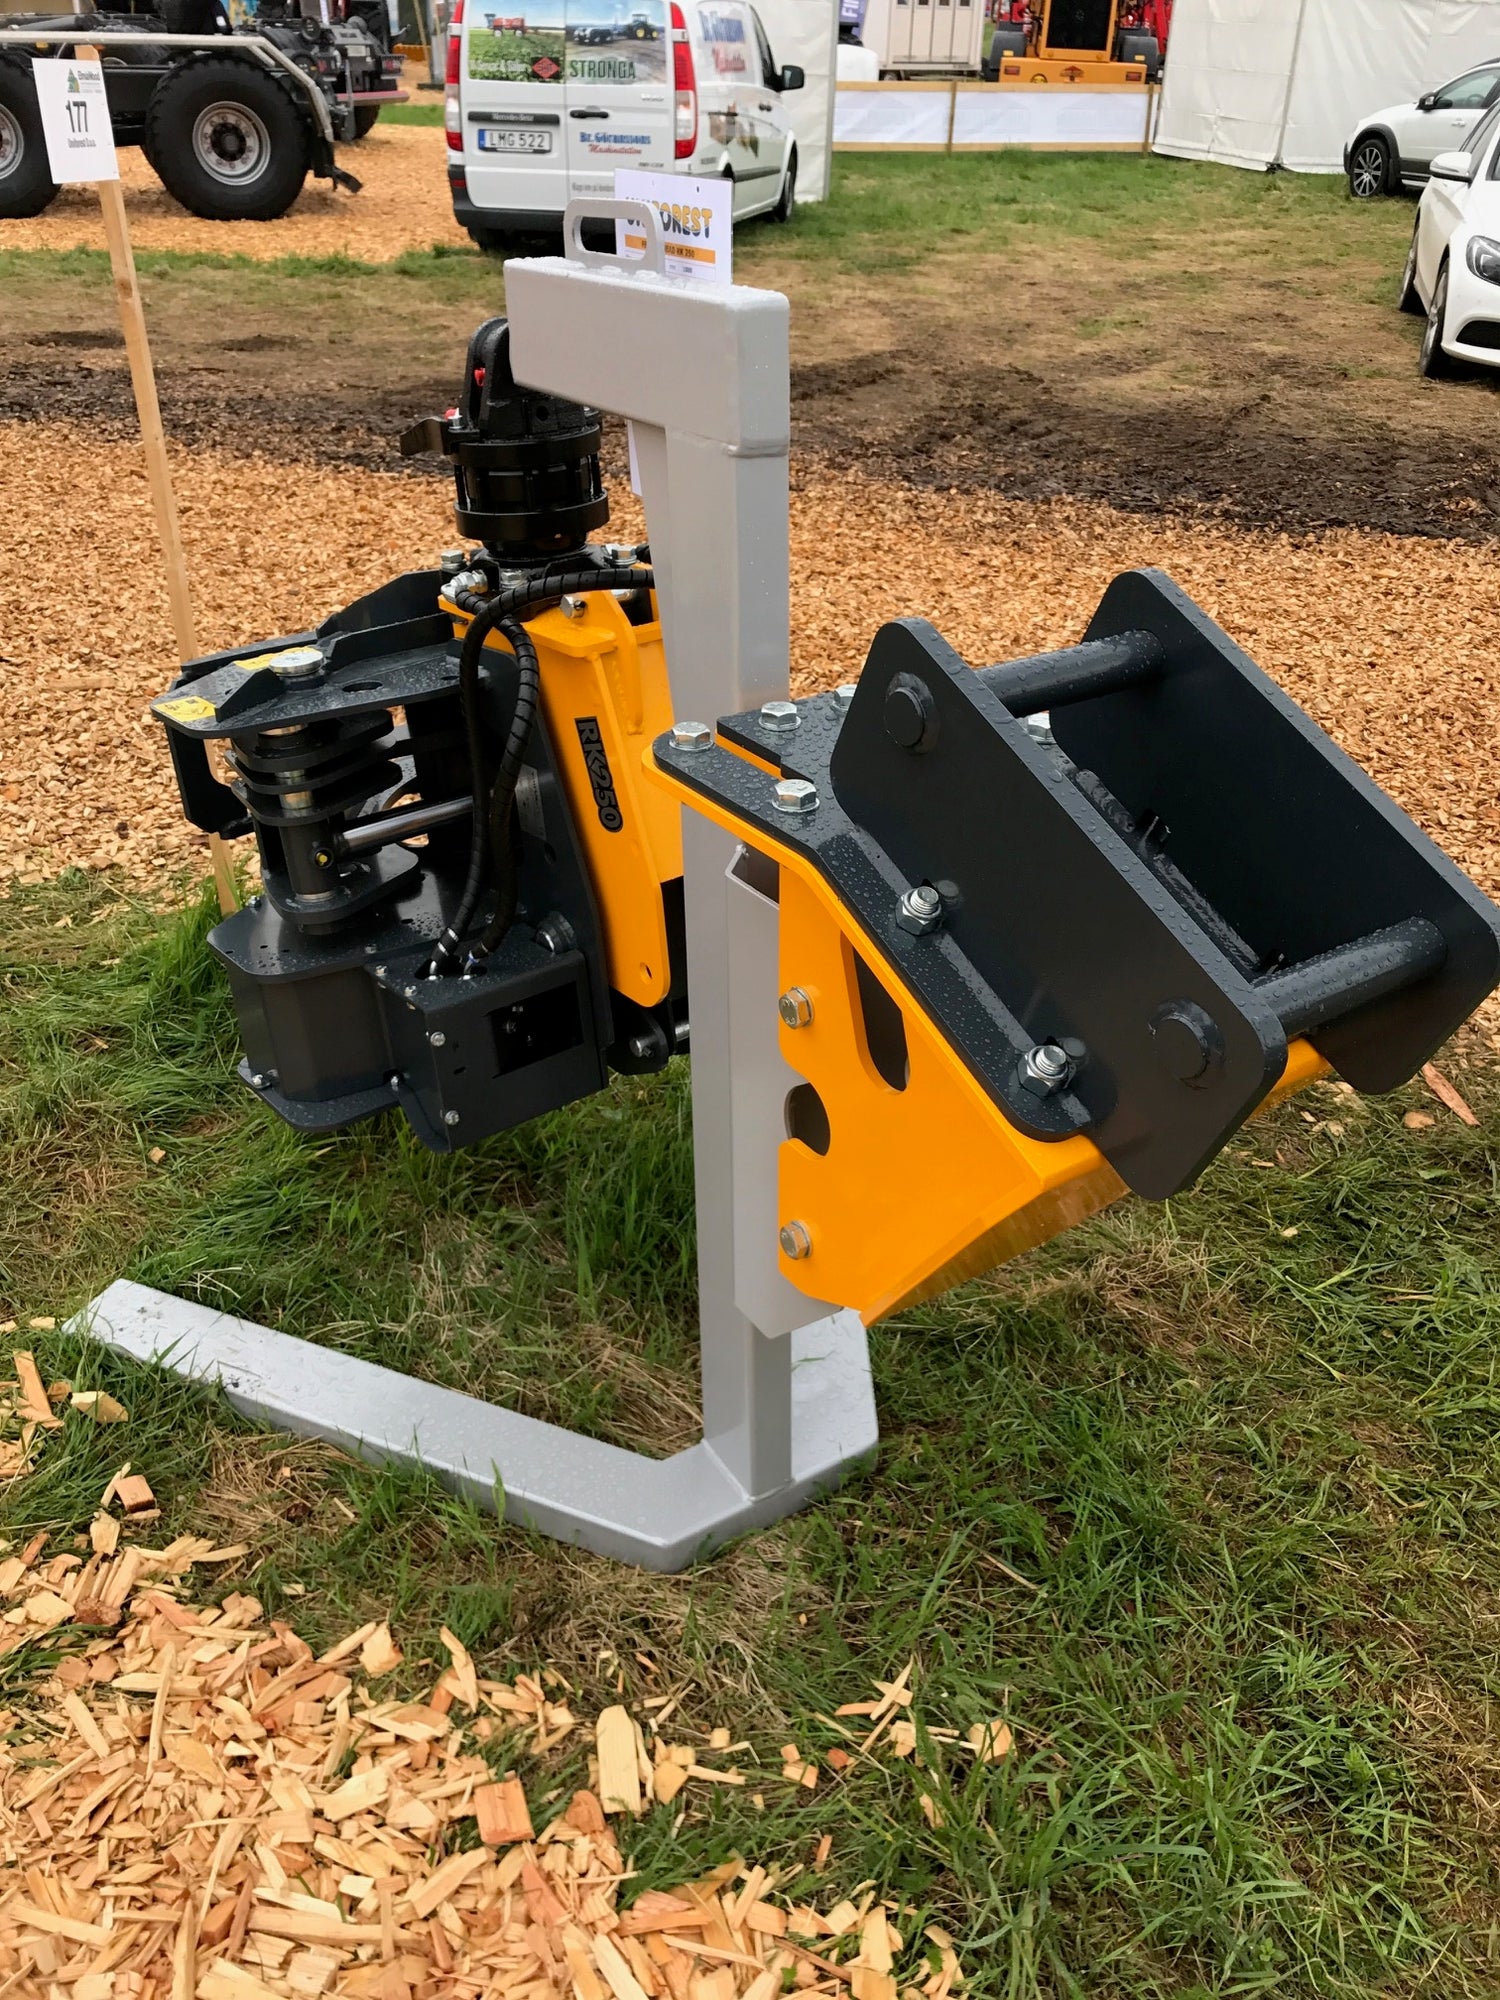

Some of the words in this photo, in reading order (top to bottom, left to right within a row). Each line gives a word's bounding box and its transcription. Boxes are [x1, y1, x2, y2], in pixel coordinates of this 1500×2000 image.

[569, 60, 636, 79] STRONGA
[65, 100, 88, 133] 177
[489, 132, 515, 147] LMG
[518, 133, 545, 148] 522
[575, 717, 623, 832] RK250
